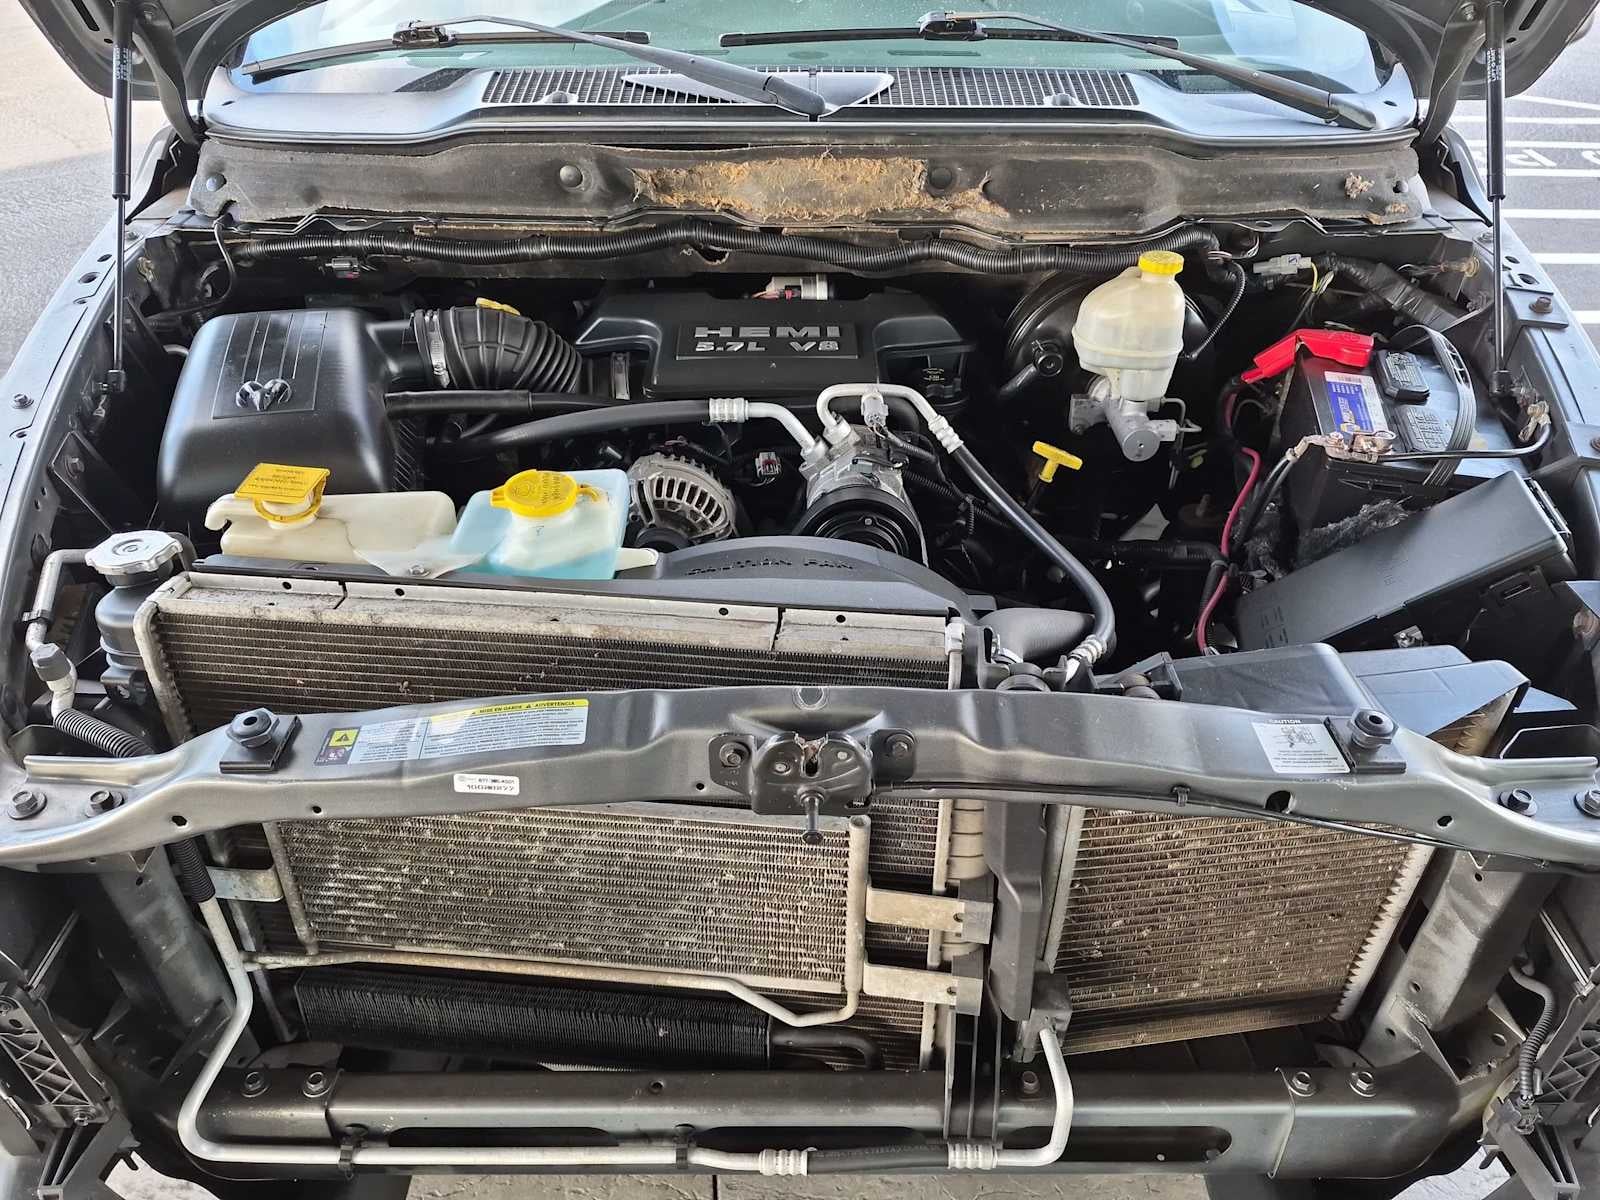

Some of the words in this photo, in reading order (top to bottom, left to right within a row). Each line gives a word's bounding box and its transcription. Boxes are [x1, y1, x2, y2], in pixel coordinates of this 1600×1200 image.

[694, 326, 841, 338] HEMI
[695, 341, 766, 352] 5.7L
[789, 341, 839, 351] V8
